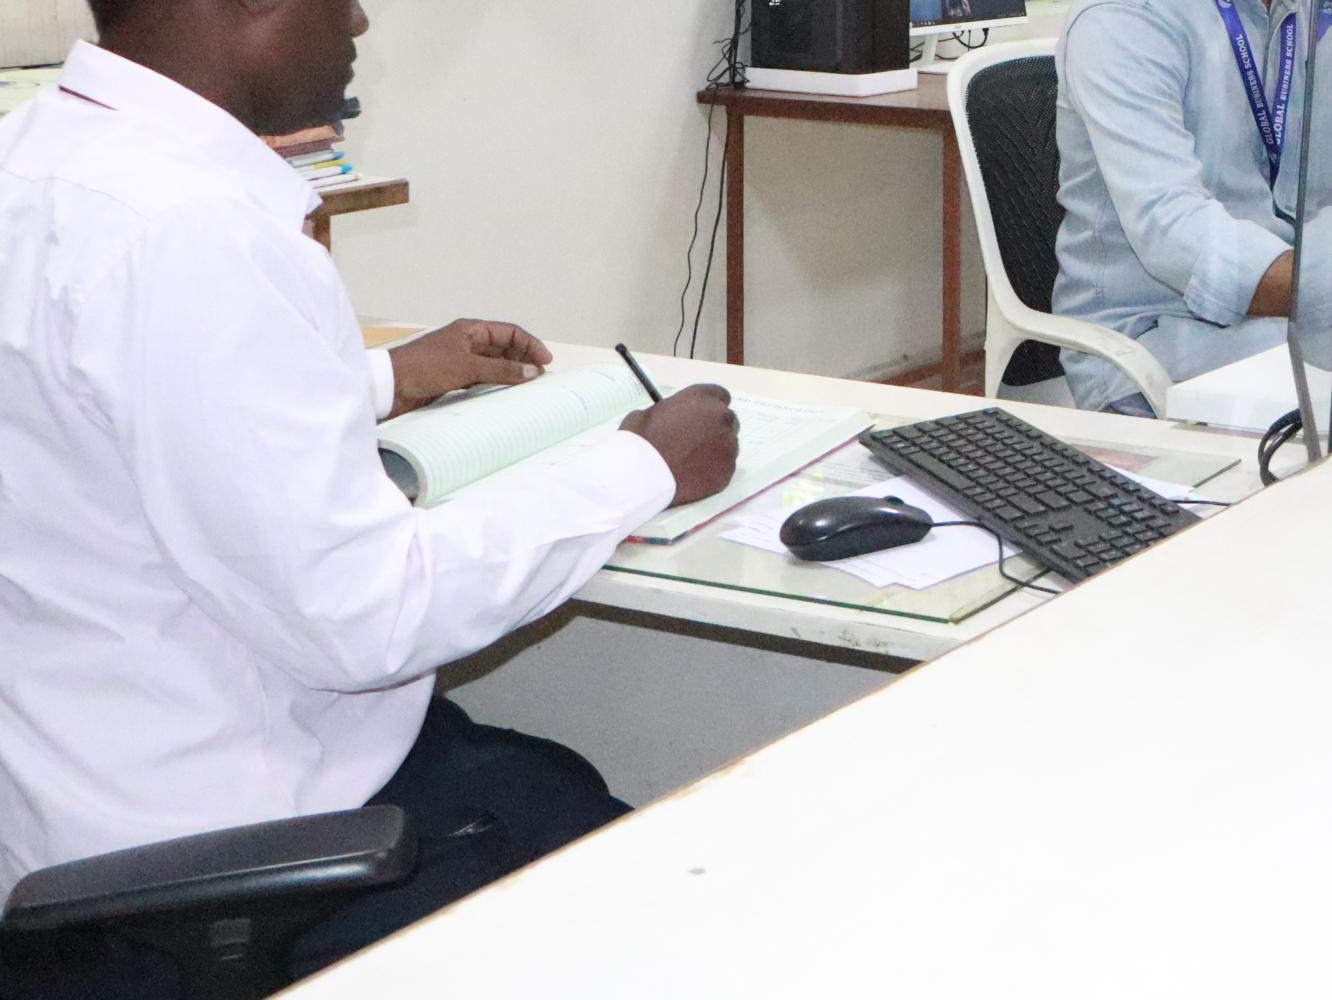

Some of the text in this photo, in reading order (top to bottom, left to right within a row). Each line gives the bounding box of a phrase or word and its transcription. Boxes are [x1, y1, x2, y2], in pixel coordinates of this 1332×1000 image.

[1285, 23, 1294, 57] SCHOOL
[1235, 33, 1274, 145] GLOBAL BUSINESS SCHOOL
[1280, 59, 1292, 101] BUSINESS
